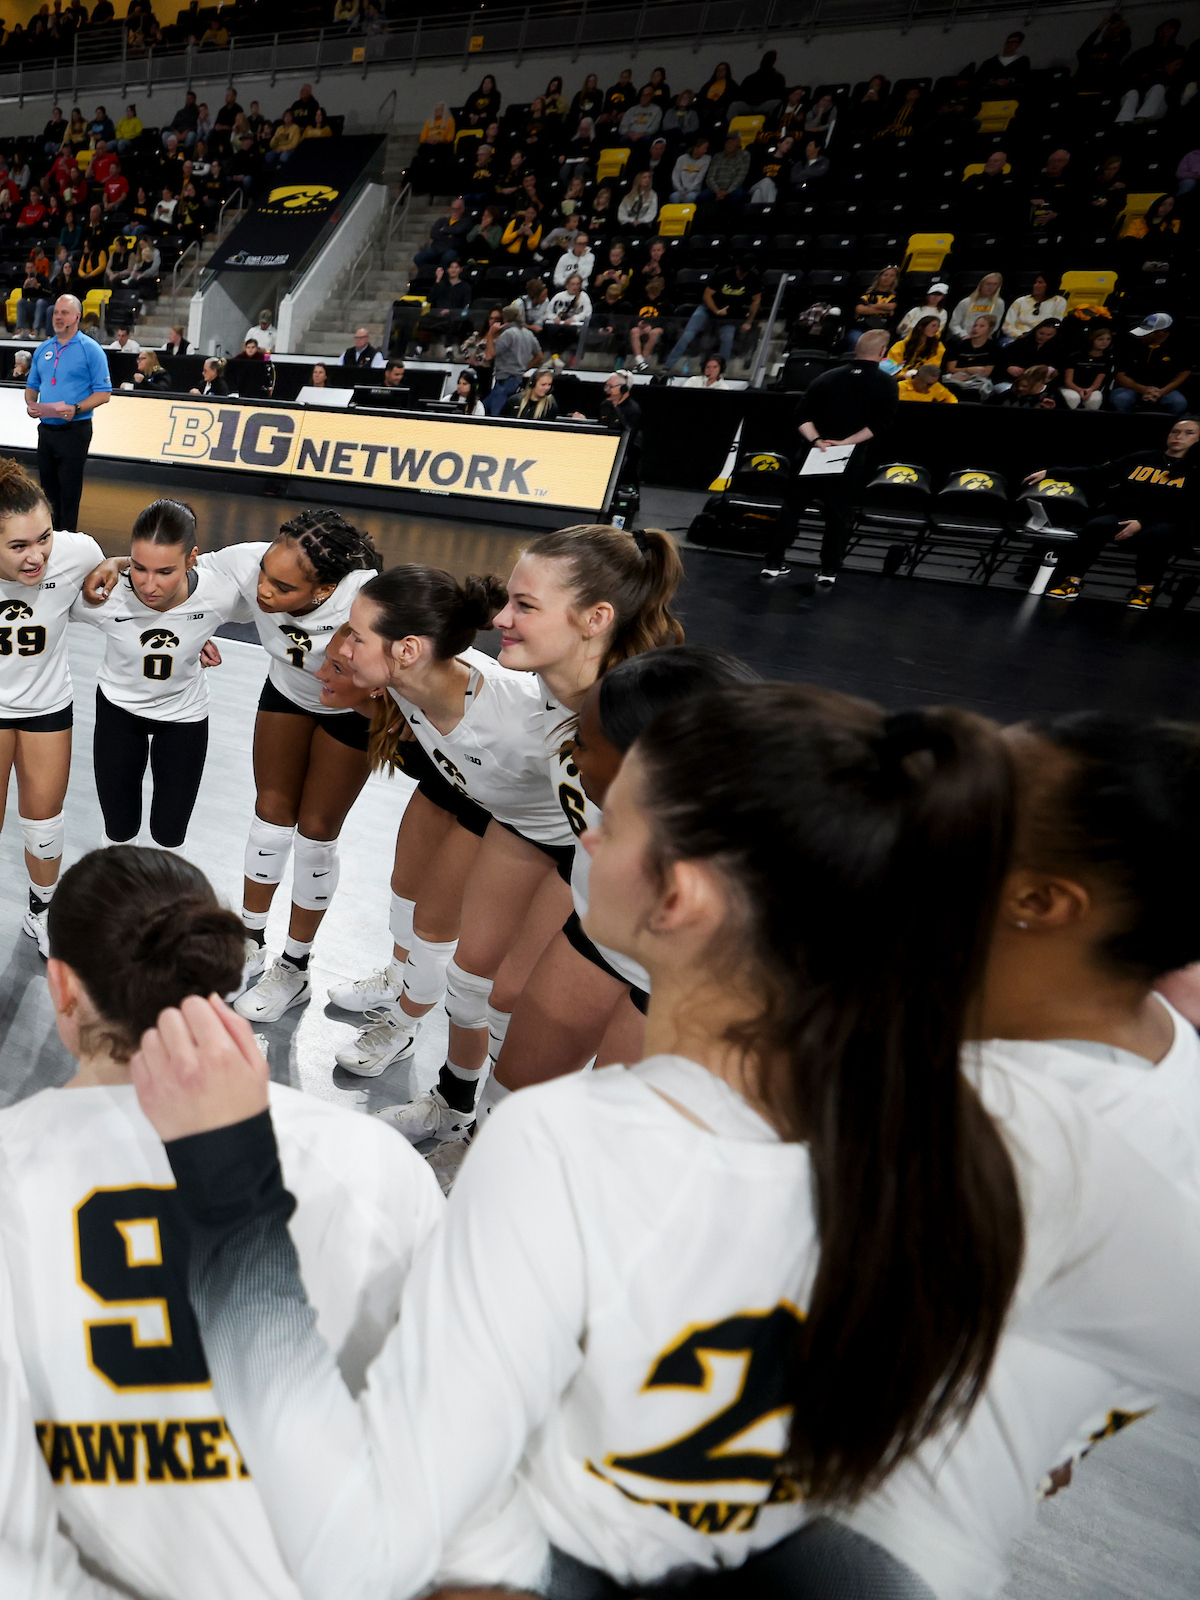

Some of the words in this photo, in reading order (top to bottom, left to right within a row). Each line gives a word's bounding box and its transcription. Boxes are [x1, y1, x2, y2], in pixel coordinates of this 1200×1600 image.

[297, 437, 538, 497] NETWORK
[1127, 465, 1186, 489] IOWA
[143, 653, 174, 681] 0
[71, 1181, 214, 1395] 9
